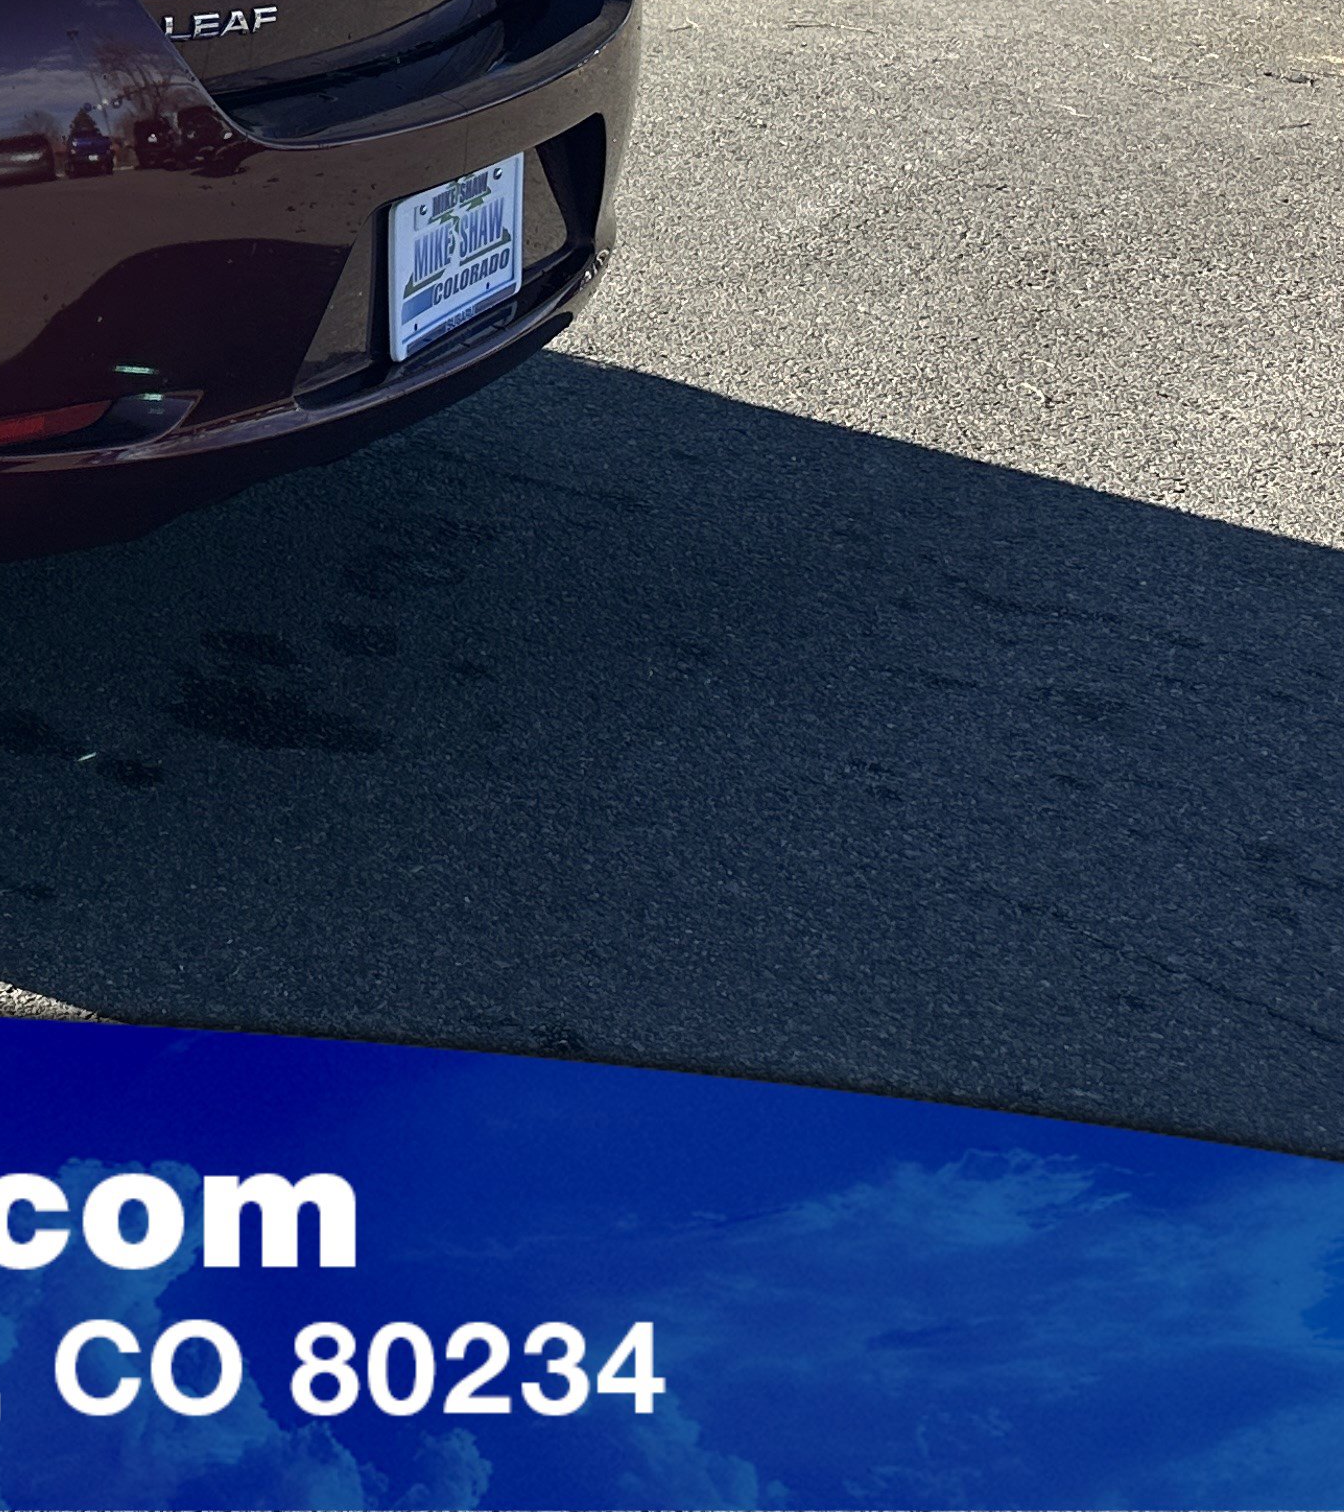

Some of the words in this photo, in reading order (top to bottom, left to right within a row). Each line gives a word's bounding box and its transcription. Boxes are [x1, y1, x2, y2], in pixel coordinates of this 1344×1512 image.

[164, 6, 278, 39] LEAF
[432, 189, 458, 218] MIKE
[460, 171, 489, 204] SHAW
[414, 223, 453, 282] MIKE
[460, 197, 505, 259] SHAW
[433, 247, 511, 306] COLORADO
